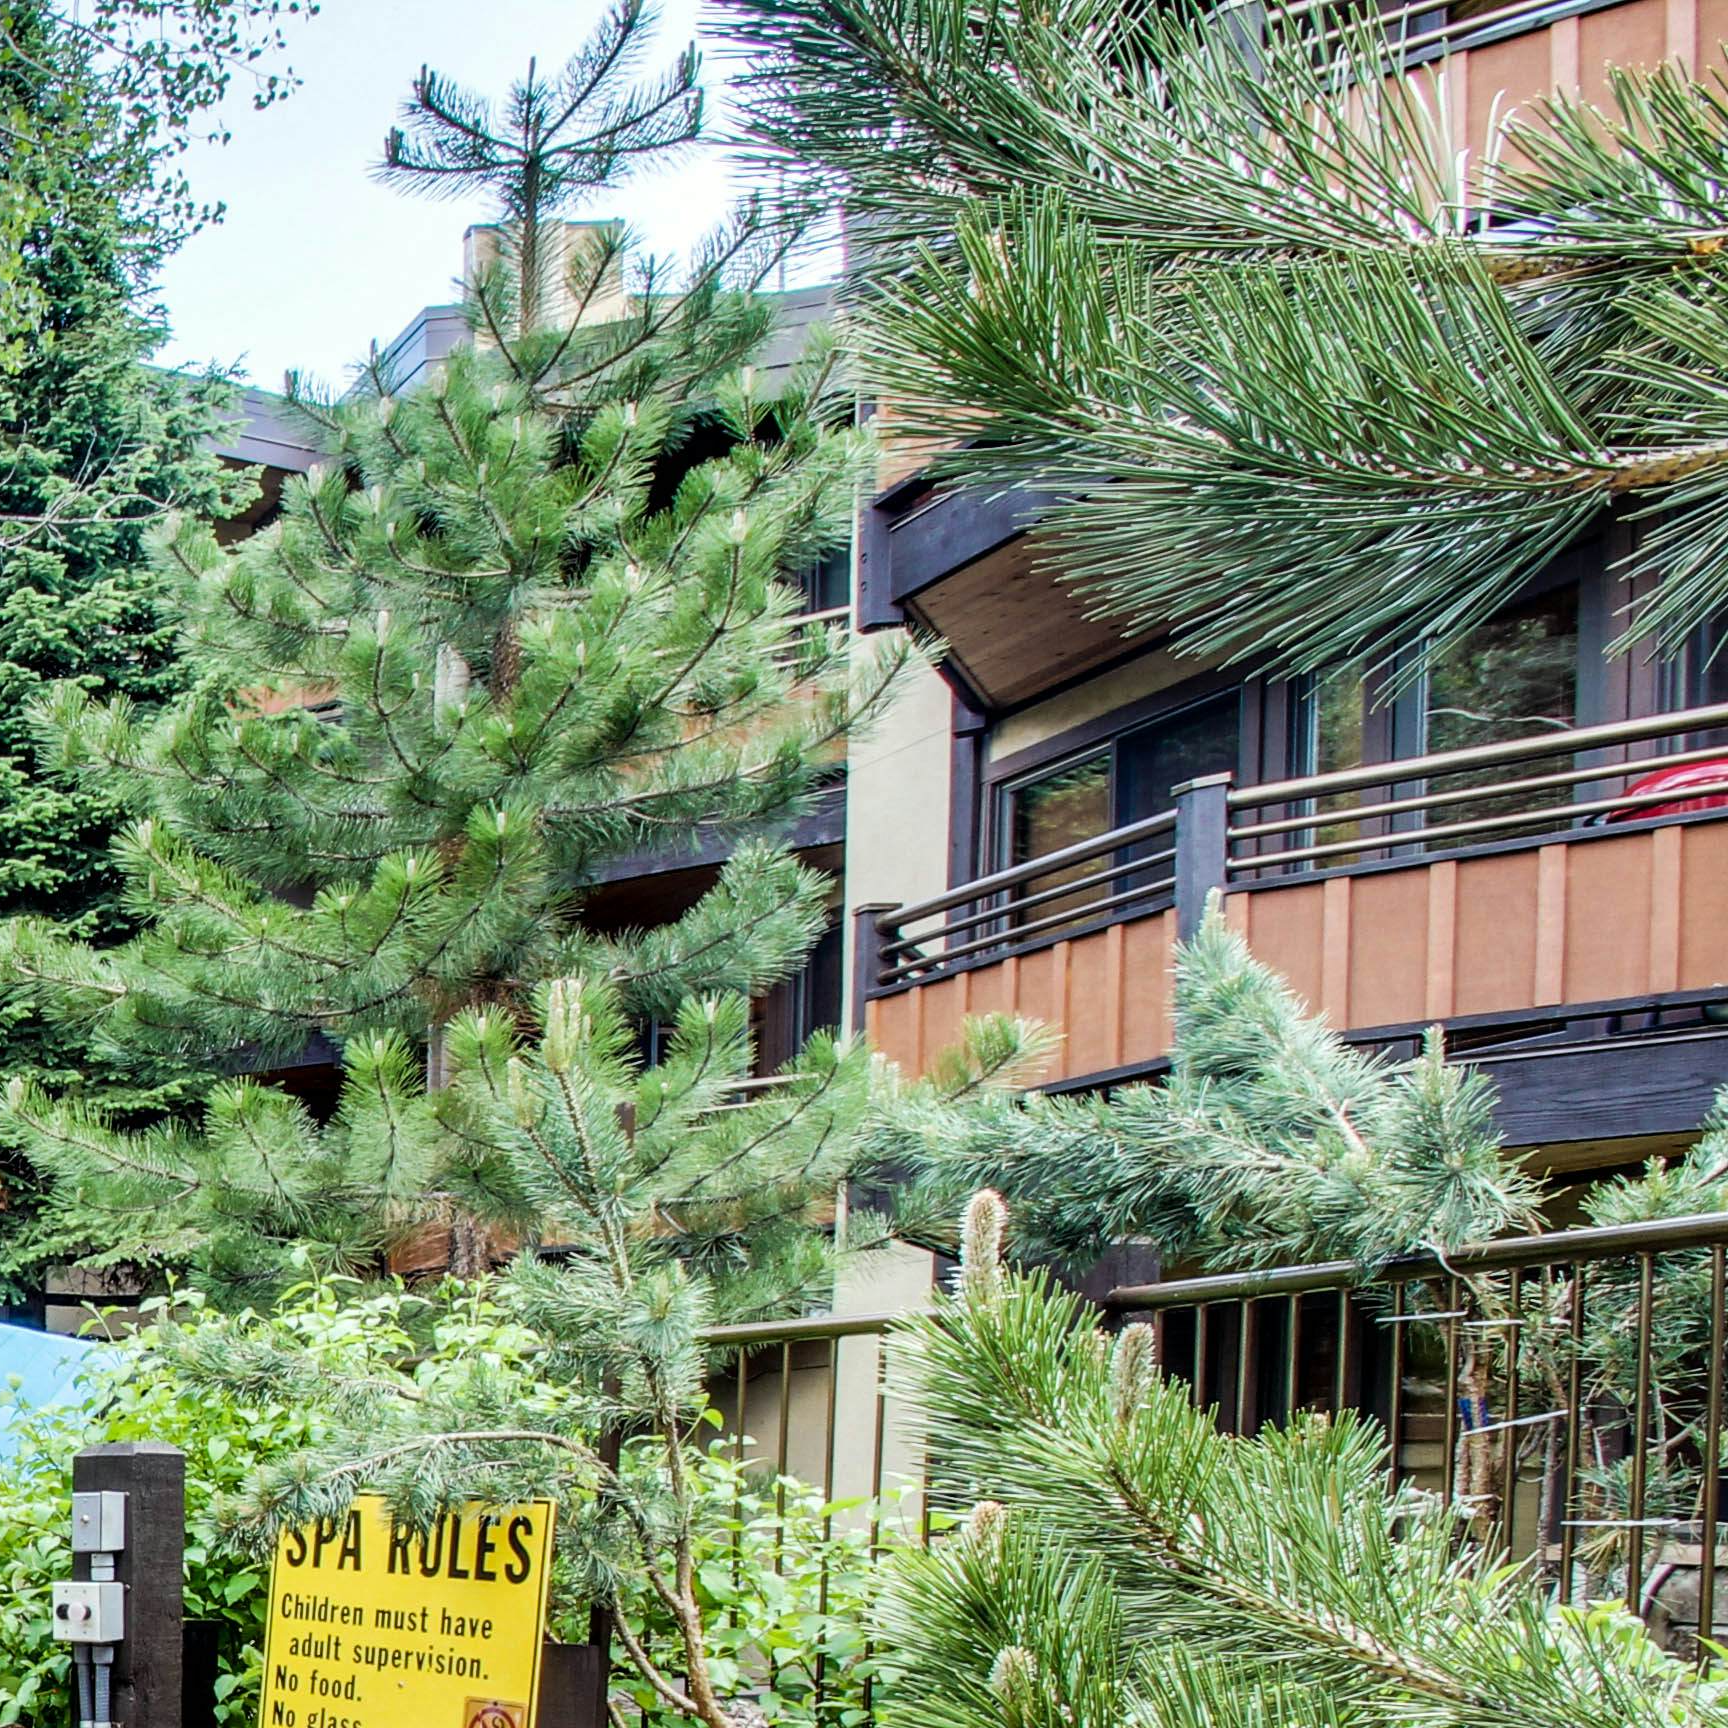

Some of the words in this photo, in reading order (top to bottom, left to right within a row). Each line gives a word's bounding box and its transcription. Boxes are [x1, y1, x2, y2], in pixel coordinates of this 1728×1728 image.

[286, 1509, 361, 1571] SPA
[388, 1511, 533, 1584] RULES
[281, 1593, 363, 1626] Children
[375, 1607, 428, 1633] must
[441, 1607, 493, 1640] have
[289, 1632, 341, 1661] adult
[352, 1643, 489, 1680] supervision.
[275, 1665, 298, 1692] No
[310, 1670, 362, 1702] food.
[272, 1701, 296, 1728] No
